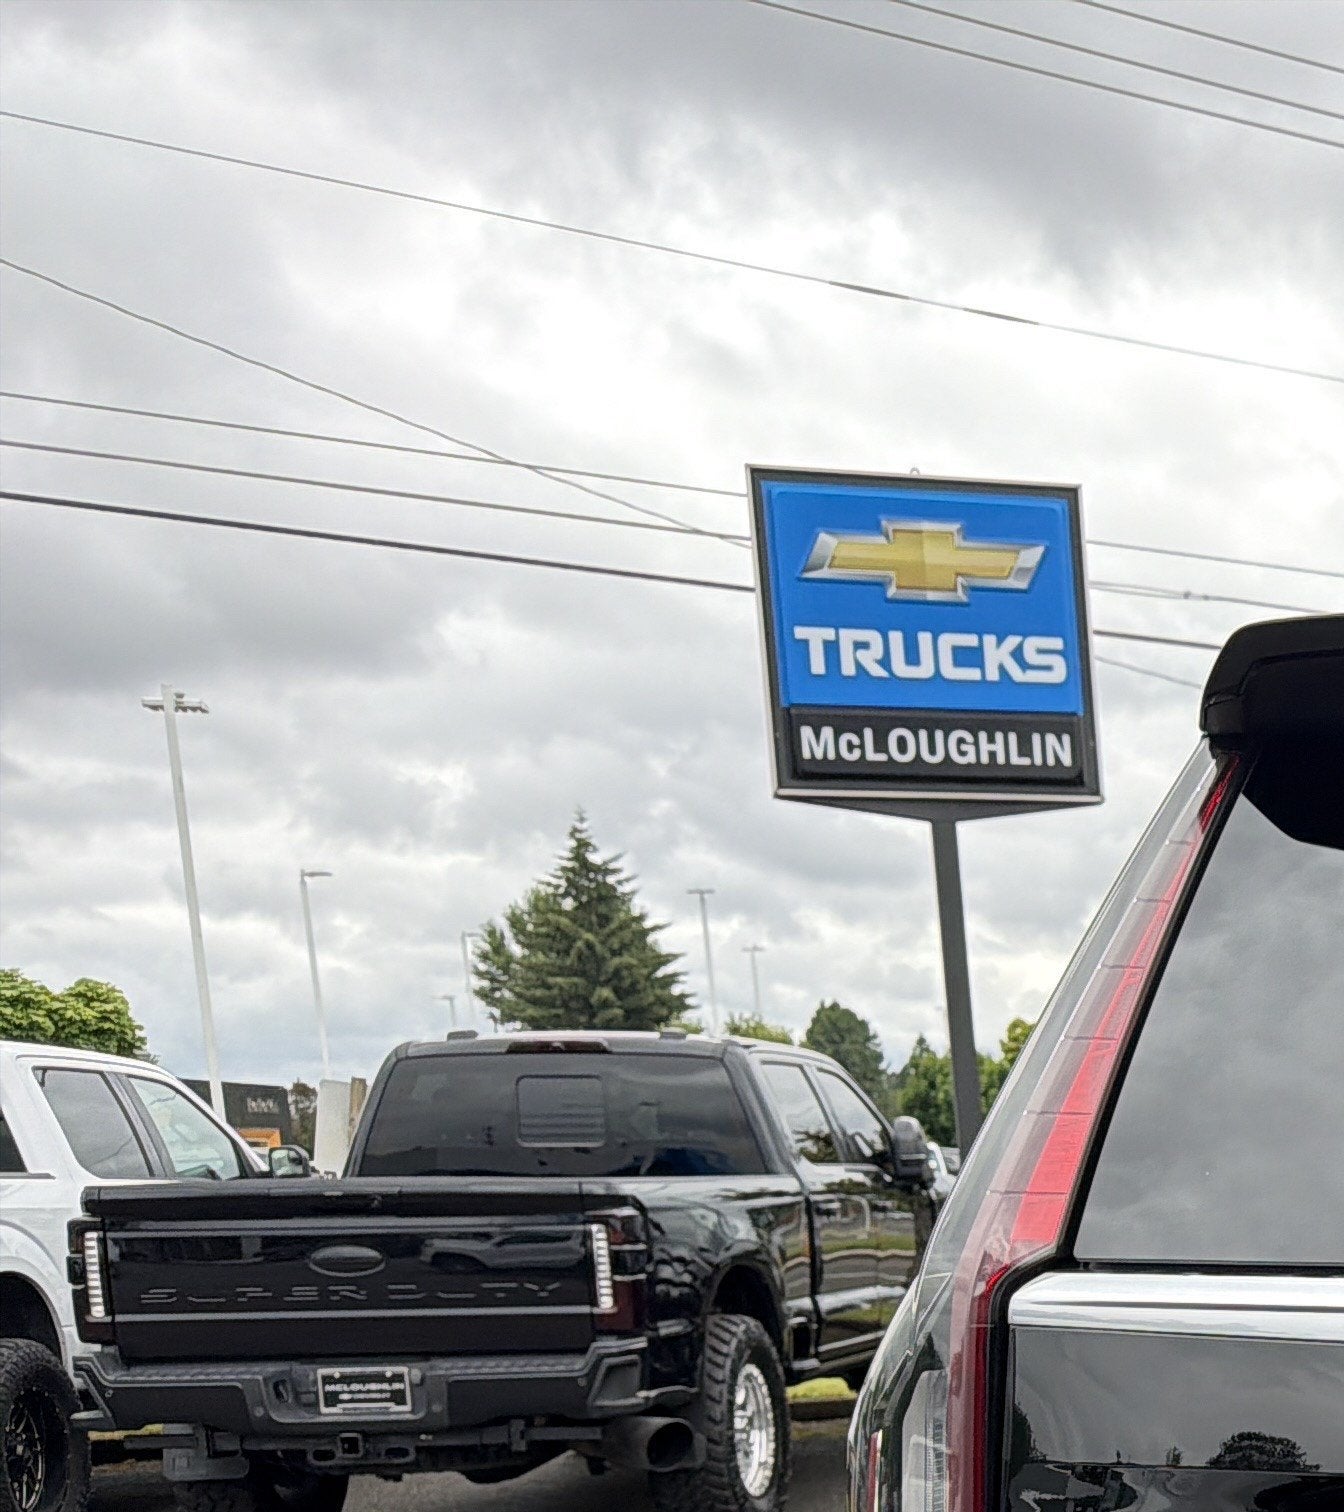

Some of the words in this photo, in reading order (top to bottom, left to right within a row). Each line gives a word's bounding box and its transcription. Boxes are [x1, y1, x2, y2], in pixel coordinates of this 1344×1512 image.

[794, 626, 1068, 683] TRUCKS
[800, 726, 1073, 767] McLOUGHLIN
[141, 1286, 368, 1303] SUPER
[387, 1281, 562, 1301] DUTY
